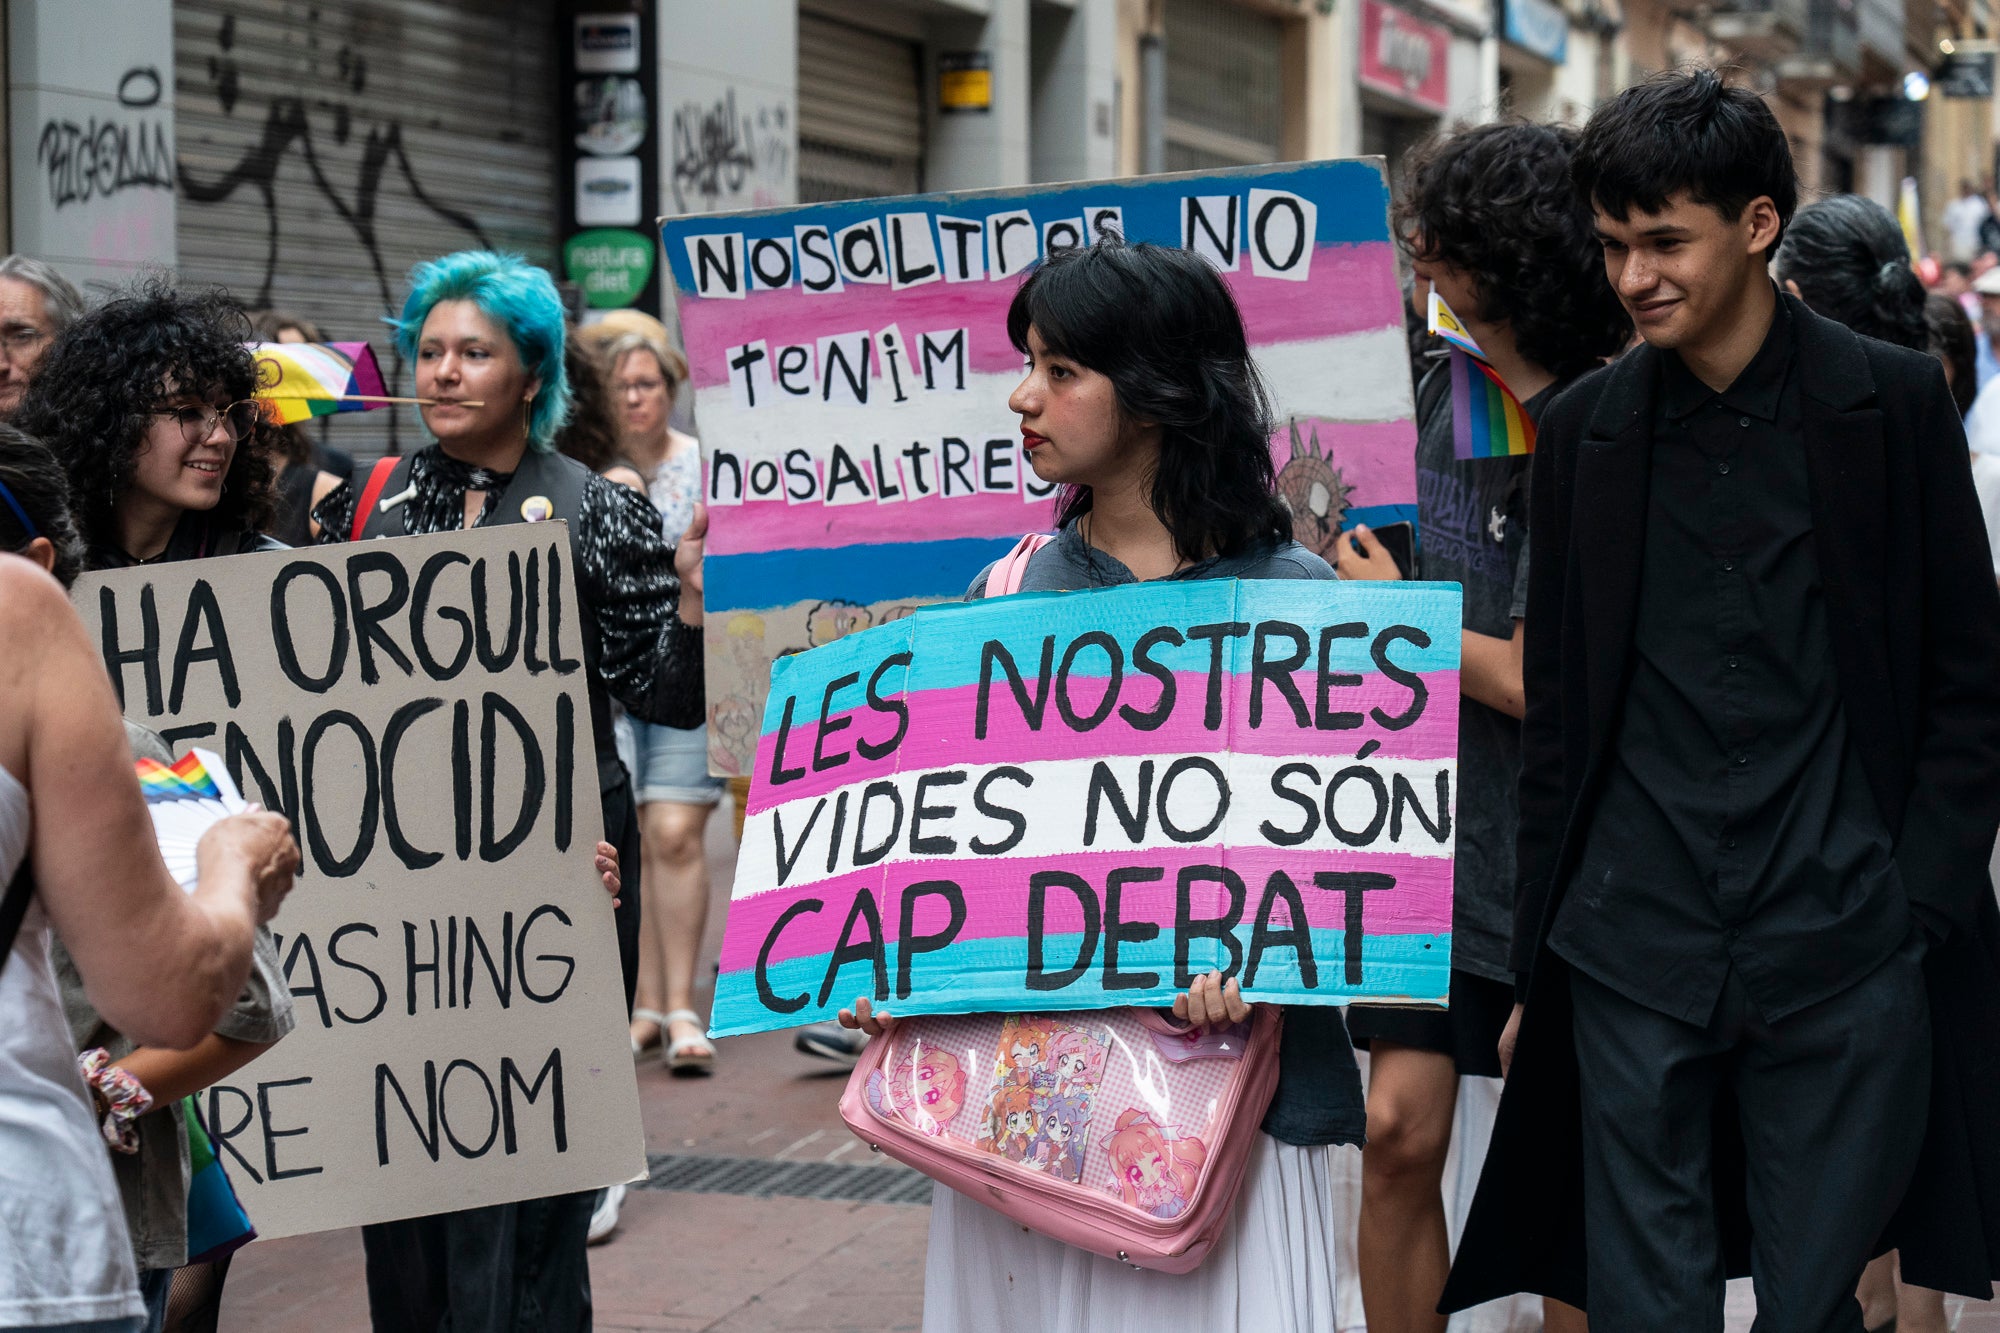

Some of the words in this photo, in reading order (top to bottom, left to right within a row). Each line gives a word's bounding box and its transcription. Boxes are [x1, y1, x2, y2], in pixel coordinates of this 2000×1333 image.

[570, 245, 647, 269] natura
[586, 267, 630, 293] diet
[1187, 195, 1304, 271] NO
[100, 579, 241, 717] HA
[271, 543, 580, 693] ORGULL
[769, 651, 914, 786] LES
[975, 621, 1432, 741] NOSTRES
[160, 692, 575, 880] NOCIDI
[774, 767, 1034, 887] VIDES
[1083, 757, 1232, 846] NO
[1260, 740, 1452, 847] SÓN
[274, 904, 575, 1028] ASHING
[755, 880, 967, 1014] CAP
[1025, 865, 1397, 992] DEBAT
[200, 1077, 324, 1185] RE
[375, 1048, 568, 1168] NOM
